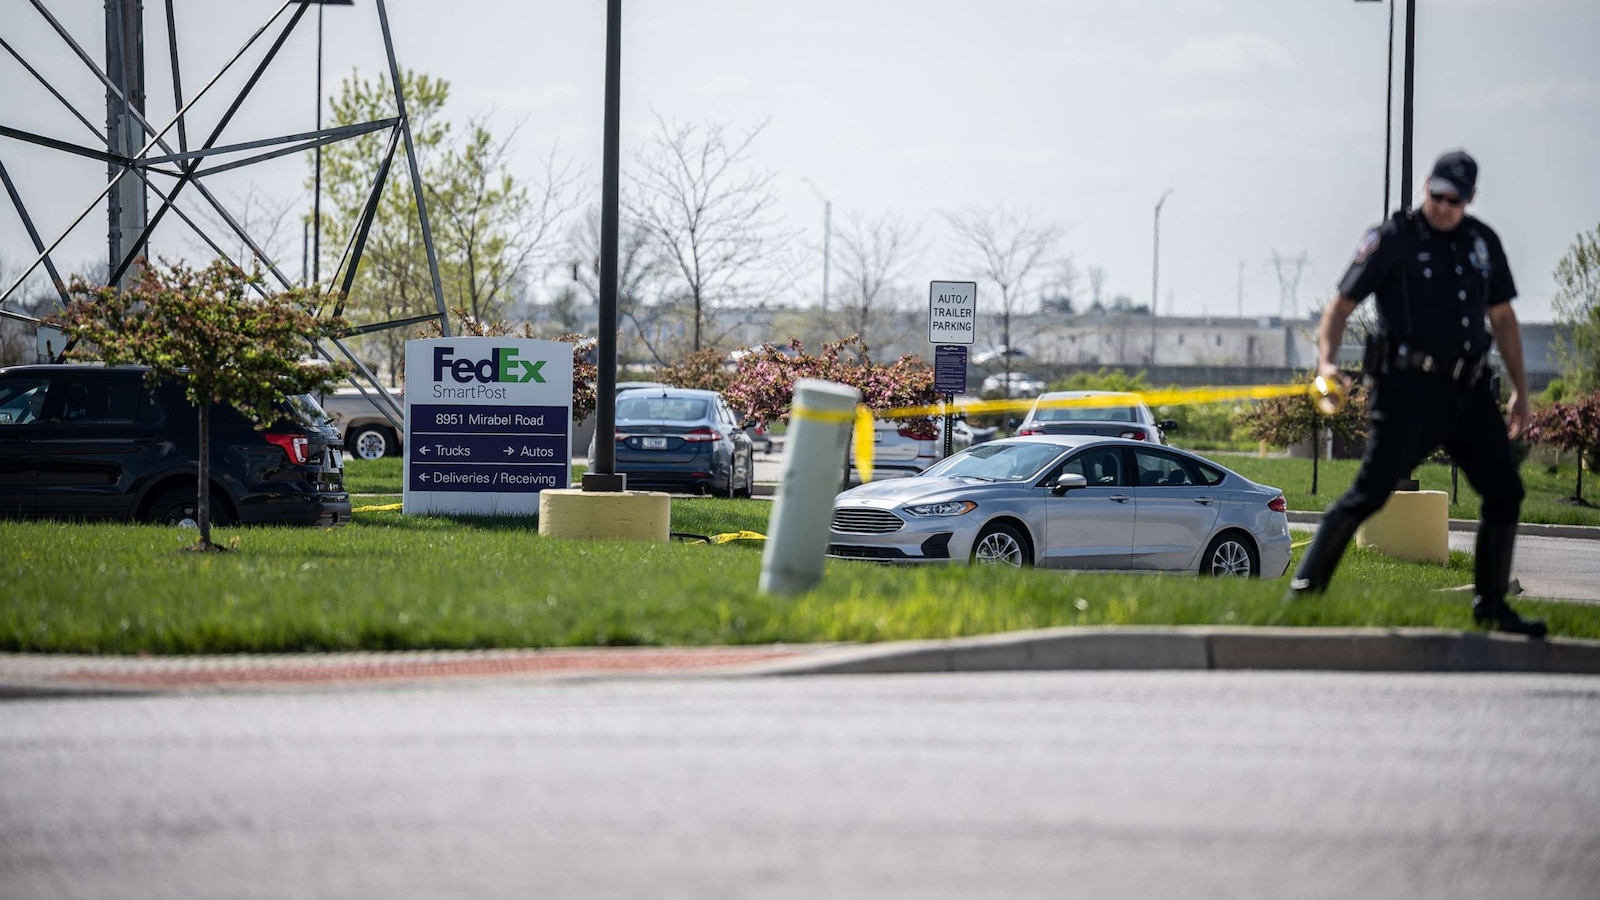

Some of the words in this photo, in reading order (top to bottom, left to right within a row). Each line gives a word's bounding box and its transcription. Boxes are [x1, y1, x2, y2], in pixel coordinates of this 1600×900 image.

[938, 295, 968, 304] AUTO/
[934, 308, 972, 317] TRAILER
[933, 322, 971, 331] PARKING
[434, 347, 546, 383] FedEx
[433, 385, 506, 399] SmartPost
[436, 414, 463, 425] 8951
[469, 414, 511, 425] Mirabel
[515, 415, 544, 426] Road
[435, 445, 470, 456] Trucks
[520, 446, 554, 456] Autos
[434, 472, 489, 484] Deliveries
[501, 473, 556, 486] Receiving
